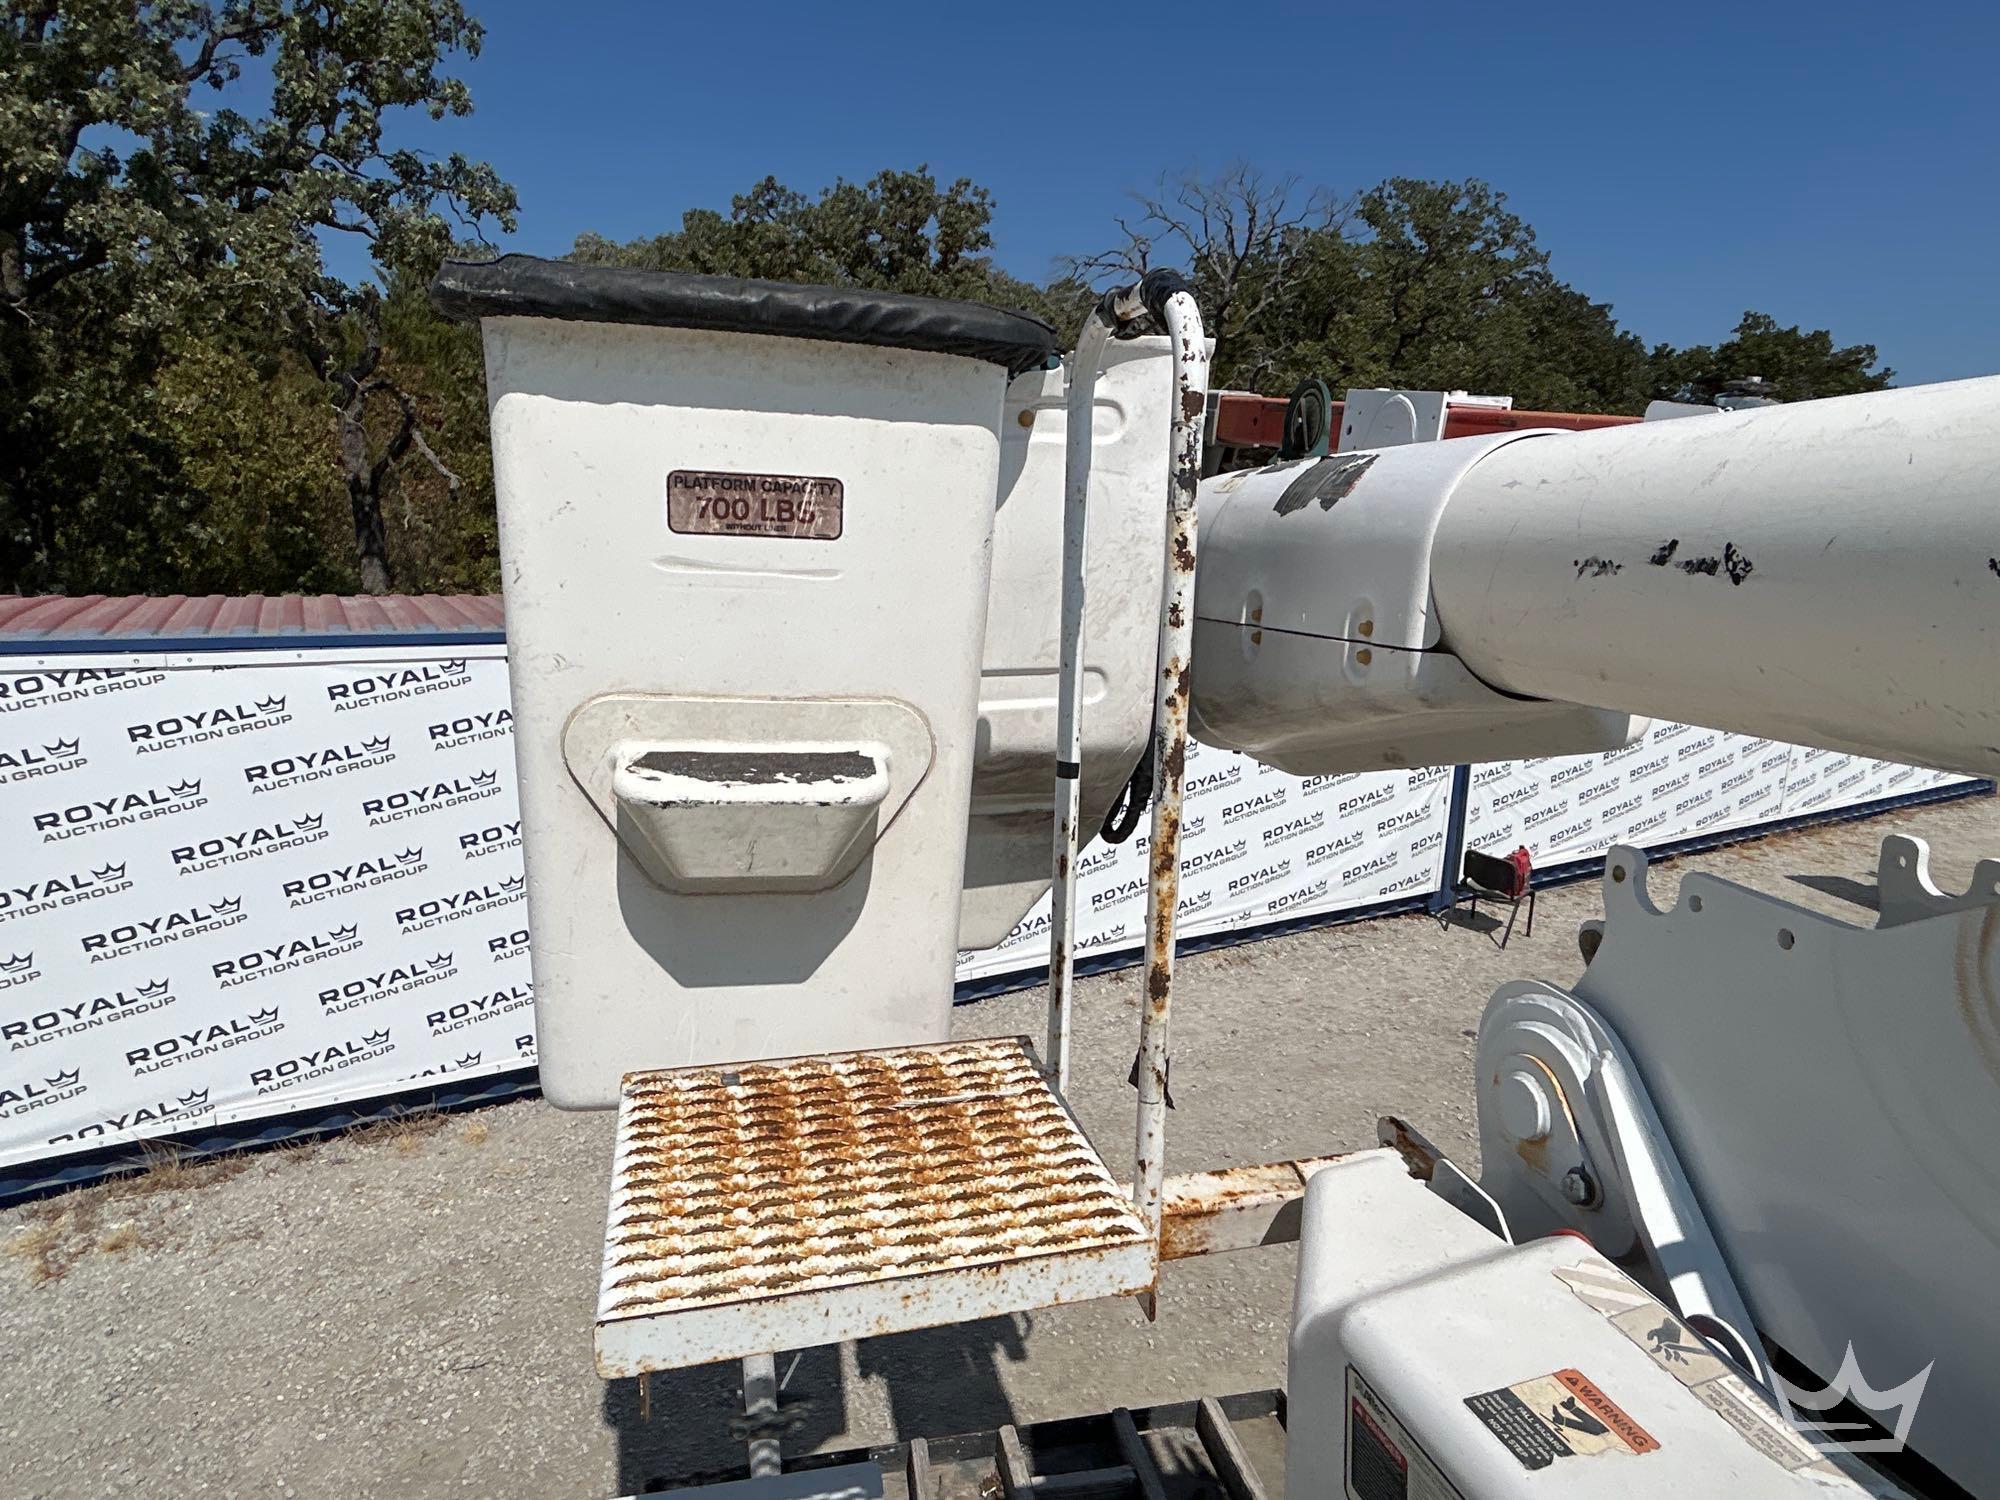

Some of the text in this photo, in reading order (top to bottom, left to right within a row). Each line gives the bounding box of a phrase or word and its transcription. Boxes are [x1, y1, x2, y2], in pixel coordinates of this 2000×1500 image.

[674, 476, 756, 491] PLATFORM
[696, 497, 815, 524] 700 LBS
[94, 674, 166, 694] GROUP
[327, 667, 440, 700] ROYAL
[334, 676, 472, 712] AUCTION GROUP
[127, 705, 257, 742] ROYAL
[136, 715, 293, 755] AUCTION GROUP
[429, 710, 513, 740] ROYA
[1654, 723, 1683, 740] ROYAL
[435, 727, 506, 751] AUCTION
[1678, 740, 1707, 756] ROYAL
[12, 758, 88, 780] GROUP
[244, 746, 363, 782] ROYAL
[252, 753, 396, 794] AUCTION GROUP
[1408, 766, 1448, 785] ROYAL
[1551, 766, 1584, 784] ROYAL
[1630, 760, 1661, 778] ROYAL
[1699, 757, 1727, 774] ROYAL
[1186, 772, 1227, 792] OYAL
[1214, 777, 1242, 790] GROUP
[1303, 782, 1335, 797] AUCTION
[1409, 778, 1437, 792] AUCTION
[1579, 781, 1611, 800] ROYAL
[1653, 778, 1682, 796] ROYAL
[1721, 772, 1747, 790] ROYAL
[362, 779, 471, 816] ROYAL
[369, 787, 501, 827] AUCTION GROUP
[1222, 794, 1272, 818] ROYAL
[1338, 790, 1382, 812] ROYAL
[1492, 787, 1530, 808] ROYAL
[1602, 800, 1635, 819] ROYAL
[1676, 794, 1706, 811] ROYAL
[1739, 788, 1765, 806] ROYAL
[34, 790, 170, 831] ROYAL
[43, 798, 209, 843] AUCTION GROUP
[1224, 799, 1287, 826] AUCTION GROUP
[1340, 804, 1370, 818] AUCTION
[1378, 810, 1420, 832] ROYAL
[1524, 806, 1560, 825] ROYAL
[1696, 810, 1724, 826] ROYAL
[459, 820, 521, 849] ROY
[1263, 817, 1311, 841] ROYAL
[1264, 821, 1324, 848] AUCTION GROUP
[1379, 823, 1409, 838] AUCTION
[1550, 823, 1583, 843] ROYAL
[1628, 815, 1660, 834] ROYAL
[171, 824, 294, 864] ROYAL
[179, 830, 329, 876] AUCTION GROUP
[465, 838, 522, 860] AUCTIO
[1306, 837, 1351, 860] ROYAL
[1307, 841, 1364, 867] AUCTION GROUP
[1411, 832, 1442, 852] ROYA
[1412, 843, 1438, 858] AUCTION
[1086, 860, 1118, 876] GROUP
[1181, 847, 1234, 871] ROYAL
[1182, 851, 1247, 879] AUCTION GROUP
[1342, 857, 1386, 880] ROYAL
[282, 857, 396, 898] ROYAL
[290, 864, 428, 909] AUCTION GROUP
[1229, 866, 1278, 891] ROYAL
[1230, 870, 1291, 898] AUCTION GROUP
[1343, 870, 1373, 887] AUCTION
[1380, 874, 1420, 896] ROYAL
[0, 874, 93, 908] YAL
[61, 880, 134, 906] GROUP
[1091, 878, 1148, 906] ROYAL
[1268, 886, 1315, 911] ROYAL
[1303, 890, 1327, 904] GROUP
[395, 885, 500, 924] ROYAL
[1093, 894, 1132, 914] AUCTION
[1184, 901, 1212, 916] GROUP
[81, 909, 212, 952] ROYAL
[402, 908, 472, 935] AUCTION
[90, 914, 247, 964] AUCTION GROUP
[998, 930, 1039, 951] AUCTION
[212, 936, 331, 978] ROYAL
[220, 940, 363, 990] AUCTION GROUP
[0, 970, 41, 990] OUP
[319, 964, 428, 1005] ROYAL
[325, 968, 458, 1016] AUCTION GROUP
[1, 992, 138, 1040] ROYAL
[426, 987, 527, 1027] ROYAL
[11, 996, 176, 1051] AUCTION GROUP
[432, 1008, 500, 1037] AUCTION
[126, 1018, 250, 1066] ROYAL
[134, 1024, 285, 1076] AUCTION GROUP
[250, 1042, 364, 1085] ROYAL
[257, 1044, 395, 1096] AUCTION GROUP
[15, 1086, 87, 1114] GROUP
[1515, 1406, 1565, 1451] FALL HAZARD
[1580, 1385, 1648, 1447] WARNING
[1486, 1418, 1504, 1432] NOT
[1506, 1439, 1529, 1458] STEP
